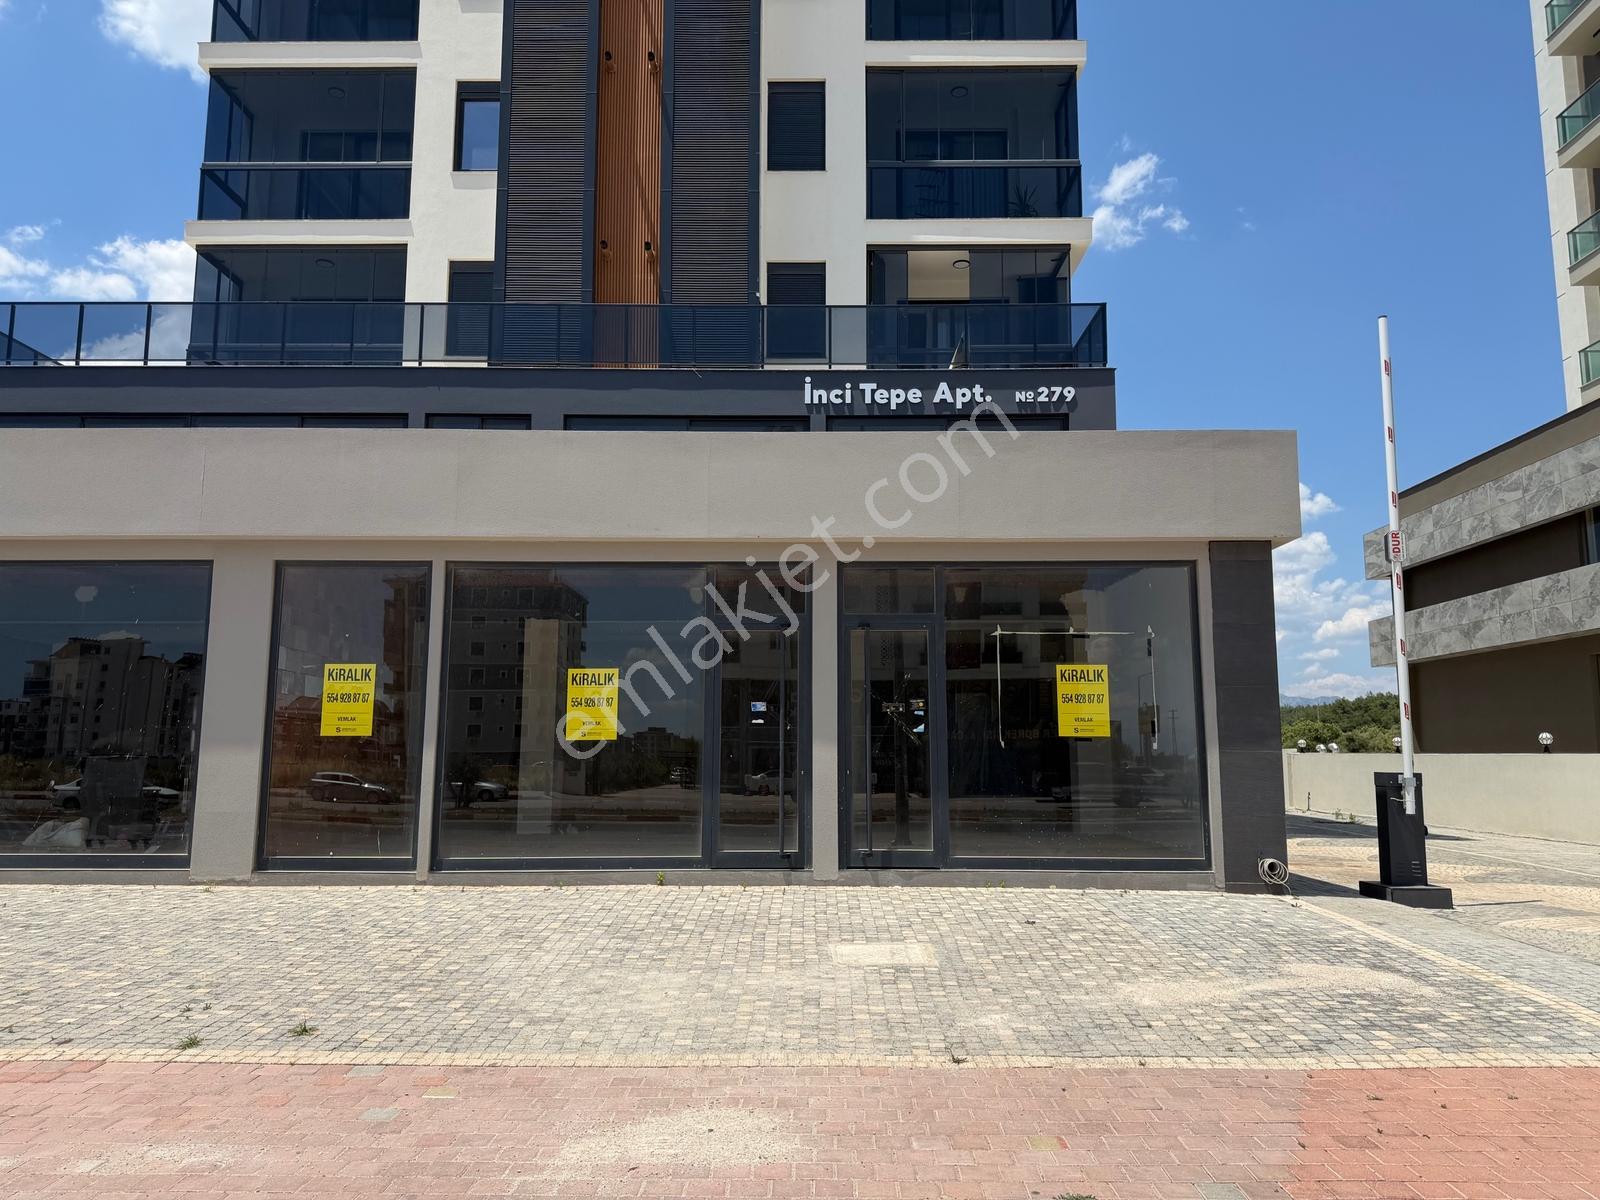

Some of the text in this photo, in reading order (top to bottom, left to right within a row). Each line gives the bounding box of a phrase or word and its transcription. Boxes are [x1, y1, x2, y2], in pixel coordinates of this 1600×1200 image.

[804, 376, 851, 405] İnci
[859, 382, 922, 410] Tepe
[932, 382, 992, 410] Apt.
[1391, 532, 1401, 553] DUR
[326, 693, 338, 703] 554
[340, 693, 351, 703] 928
[352, 693, 360, 703] 87
[571, 697, 582, 707] 554
[1061, 693, 1104, 704] 554 928 87 87
